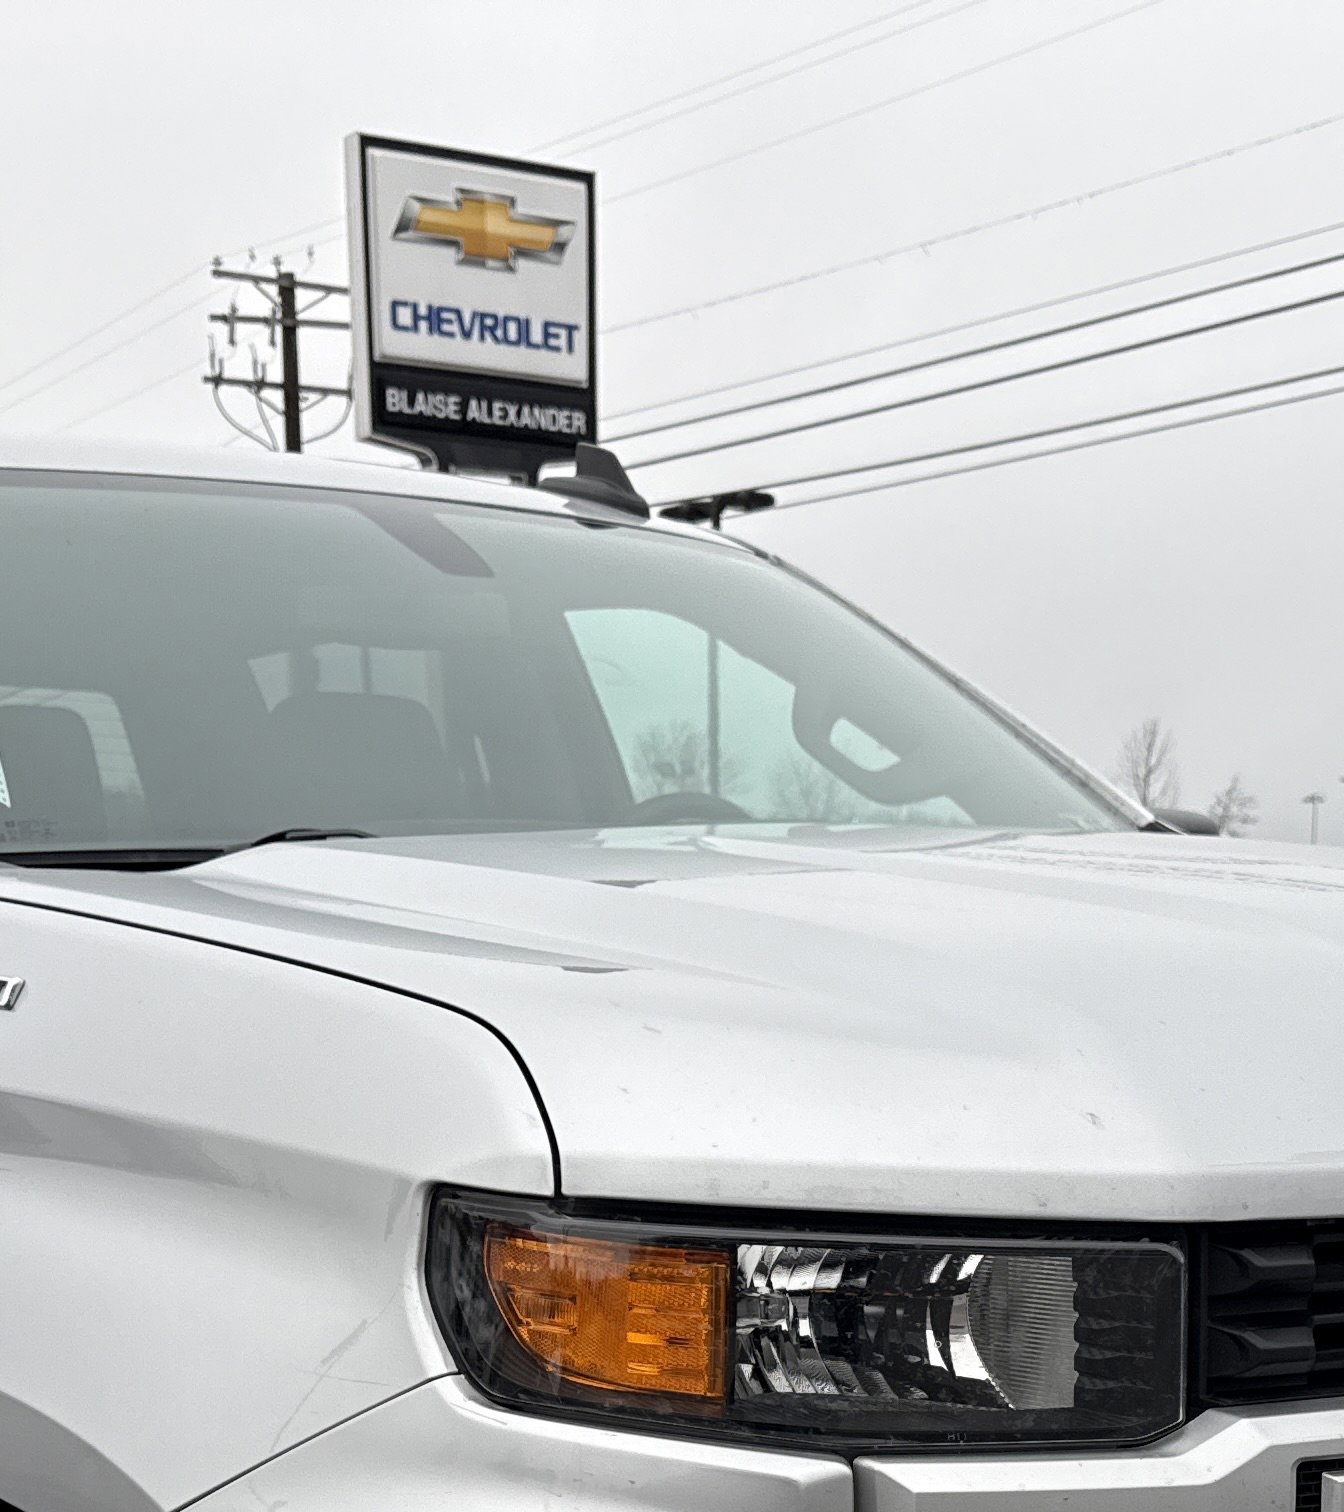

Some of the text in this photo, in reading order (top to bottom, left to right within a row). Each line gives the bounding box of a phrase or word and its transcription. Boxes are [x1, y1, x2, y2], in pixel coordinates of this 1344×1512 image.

[390, 300, 580, 353] CHEVROLET
[384, 386, 588, 436] BLAISE ALEXANDER
